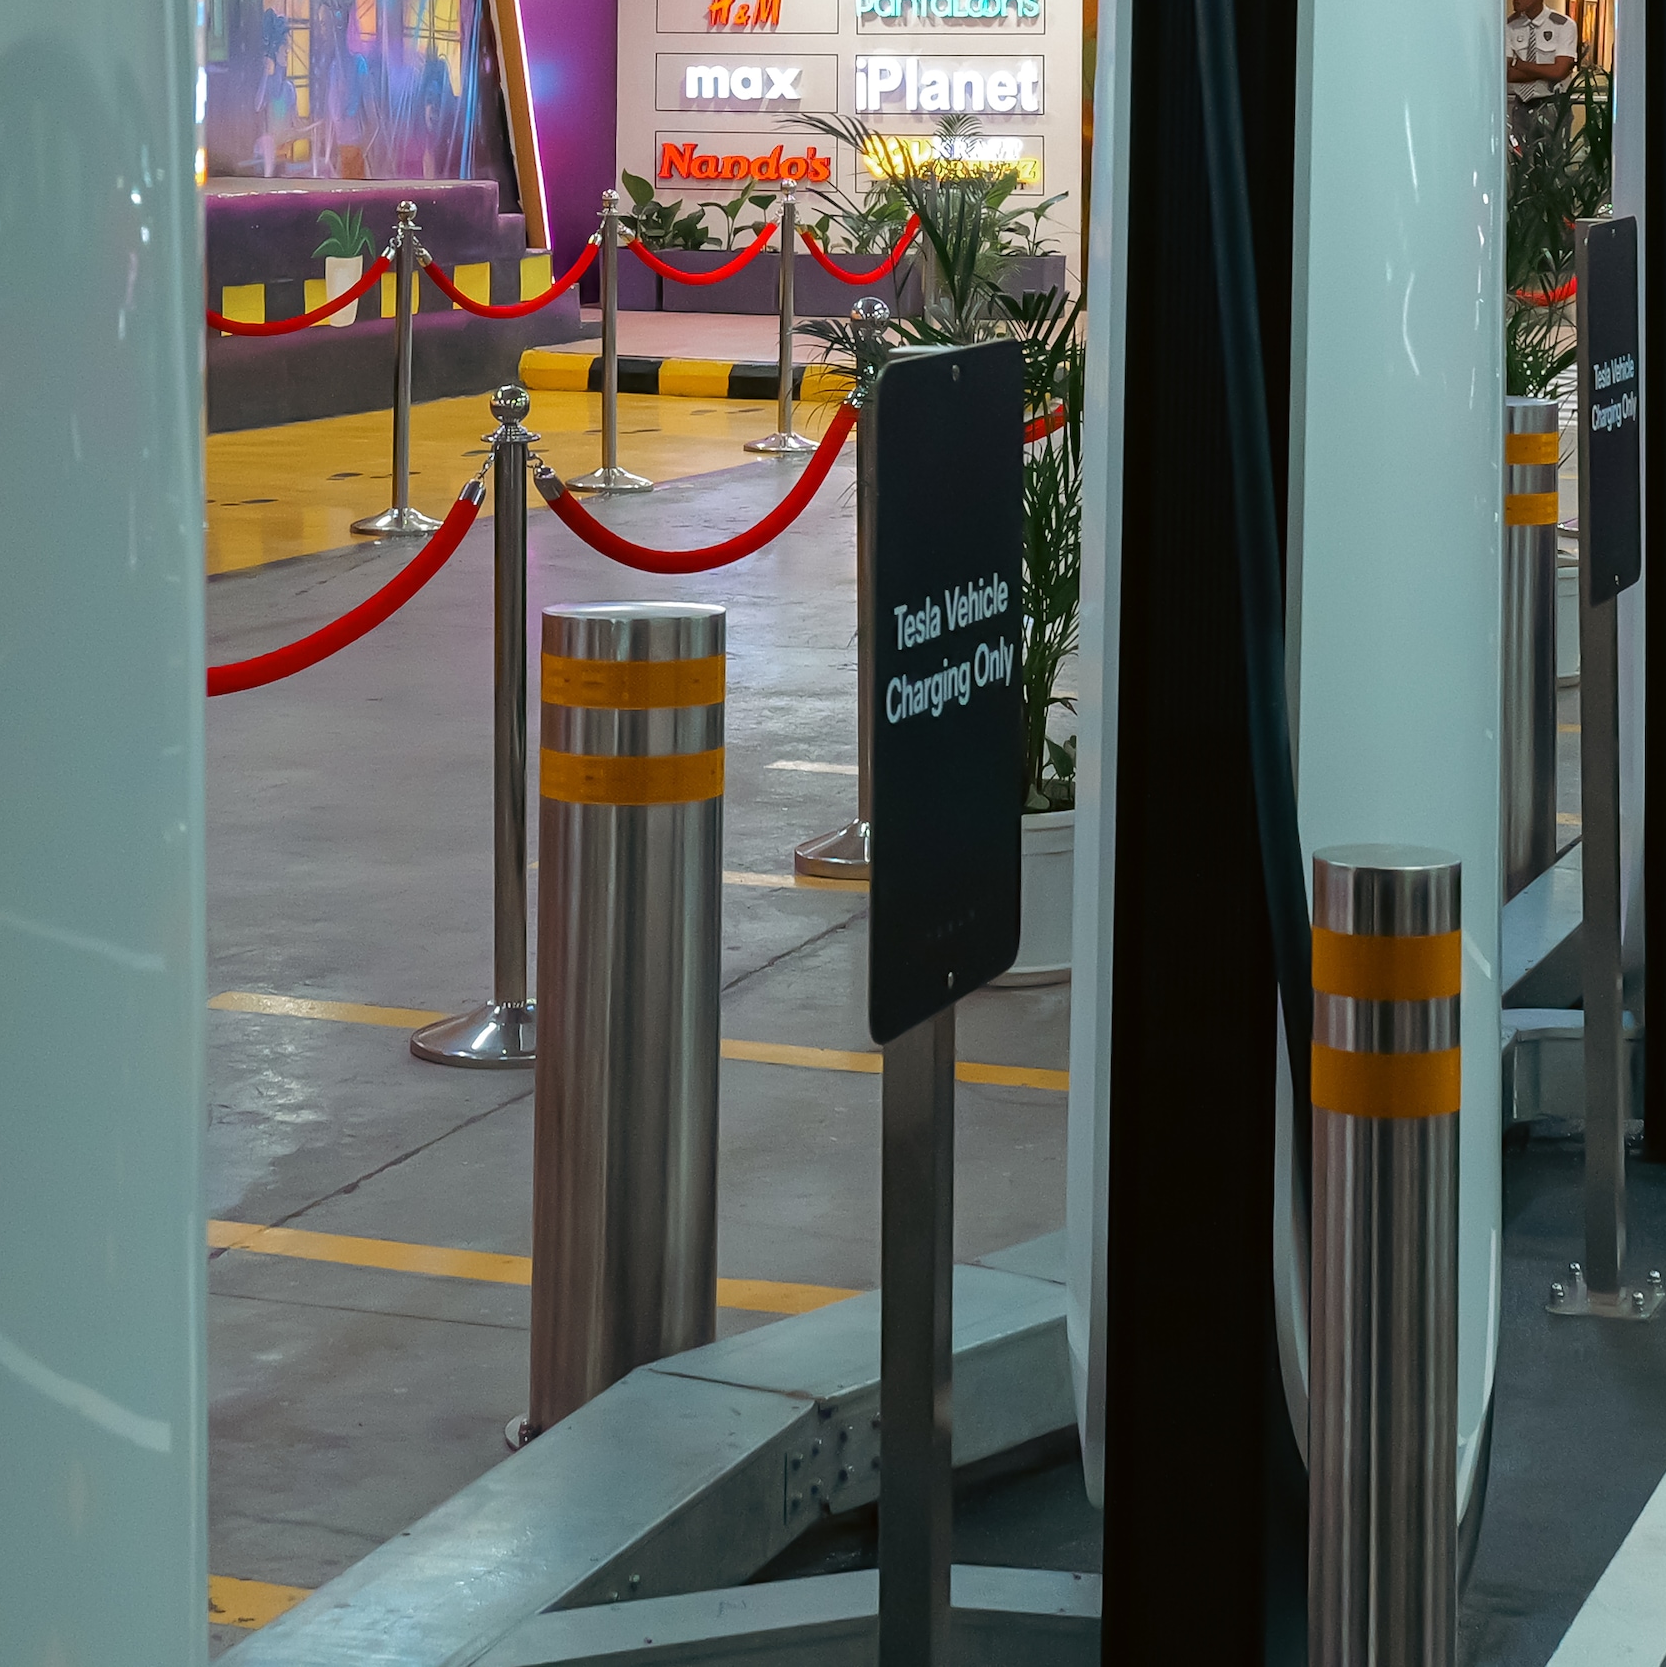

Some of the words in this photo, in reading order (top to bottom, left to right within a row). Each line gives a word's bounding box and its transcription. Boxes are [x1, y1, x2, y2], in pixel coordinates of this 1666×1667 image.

[685, 66, 803, 101] max
[856, 57, 1039, 112] iPlanet
[658, 143, 831, 182] Nando's
[893, 595, 941, 651] Tesla
[944, 572, 1009, 632] Vehicle
[885, 657, 971, 724] Charging
[973, 635, 1015, 687] Only
